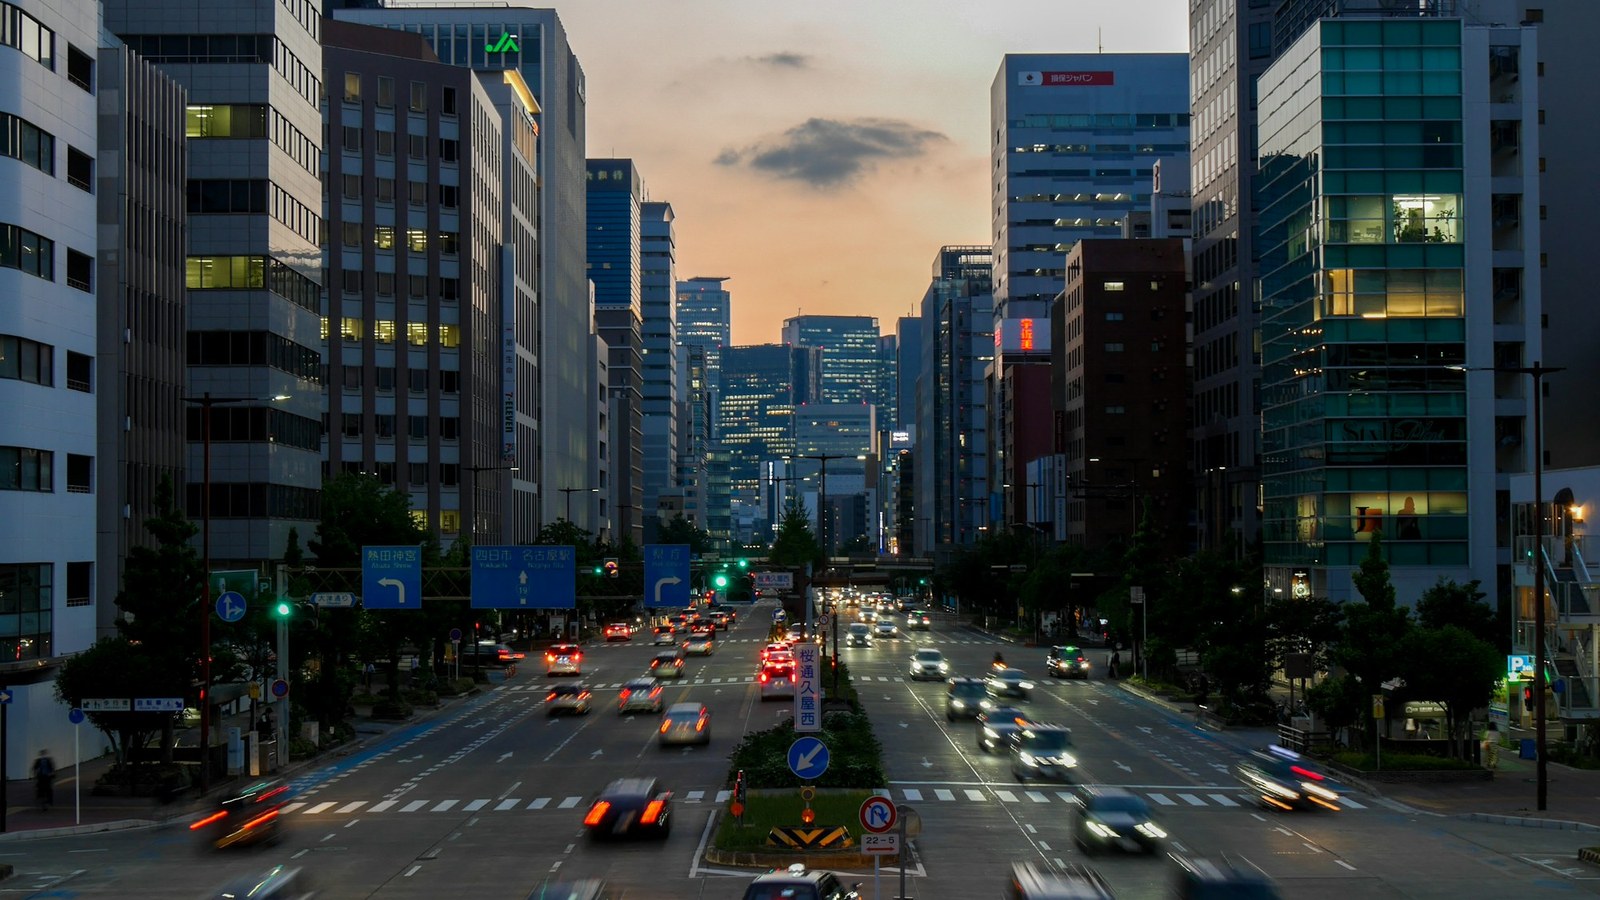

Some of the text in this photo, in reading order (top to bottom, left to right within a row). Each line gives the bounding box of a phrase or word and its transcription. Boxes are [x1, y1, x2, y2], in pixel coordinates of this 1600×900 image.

[1051, 74, 1093, 83] 損保ジャパン
[367, 550, 417, 562] 熱田神宮
[475, 549, 512, 561] 四日市
[522, 549, 570, 561] 名古屋駅
[519, 586, 528, 594] 19
[800, 649, 815, 726] 桜通久屋西
